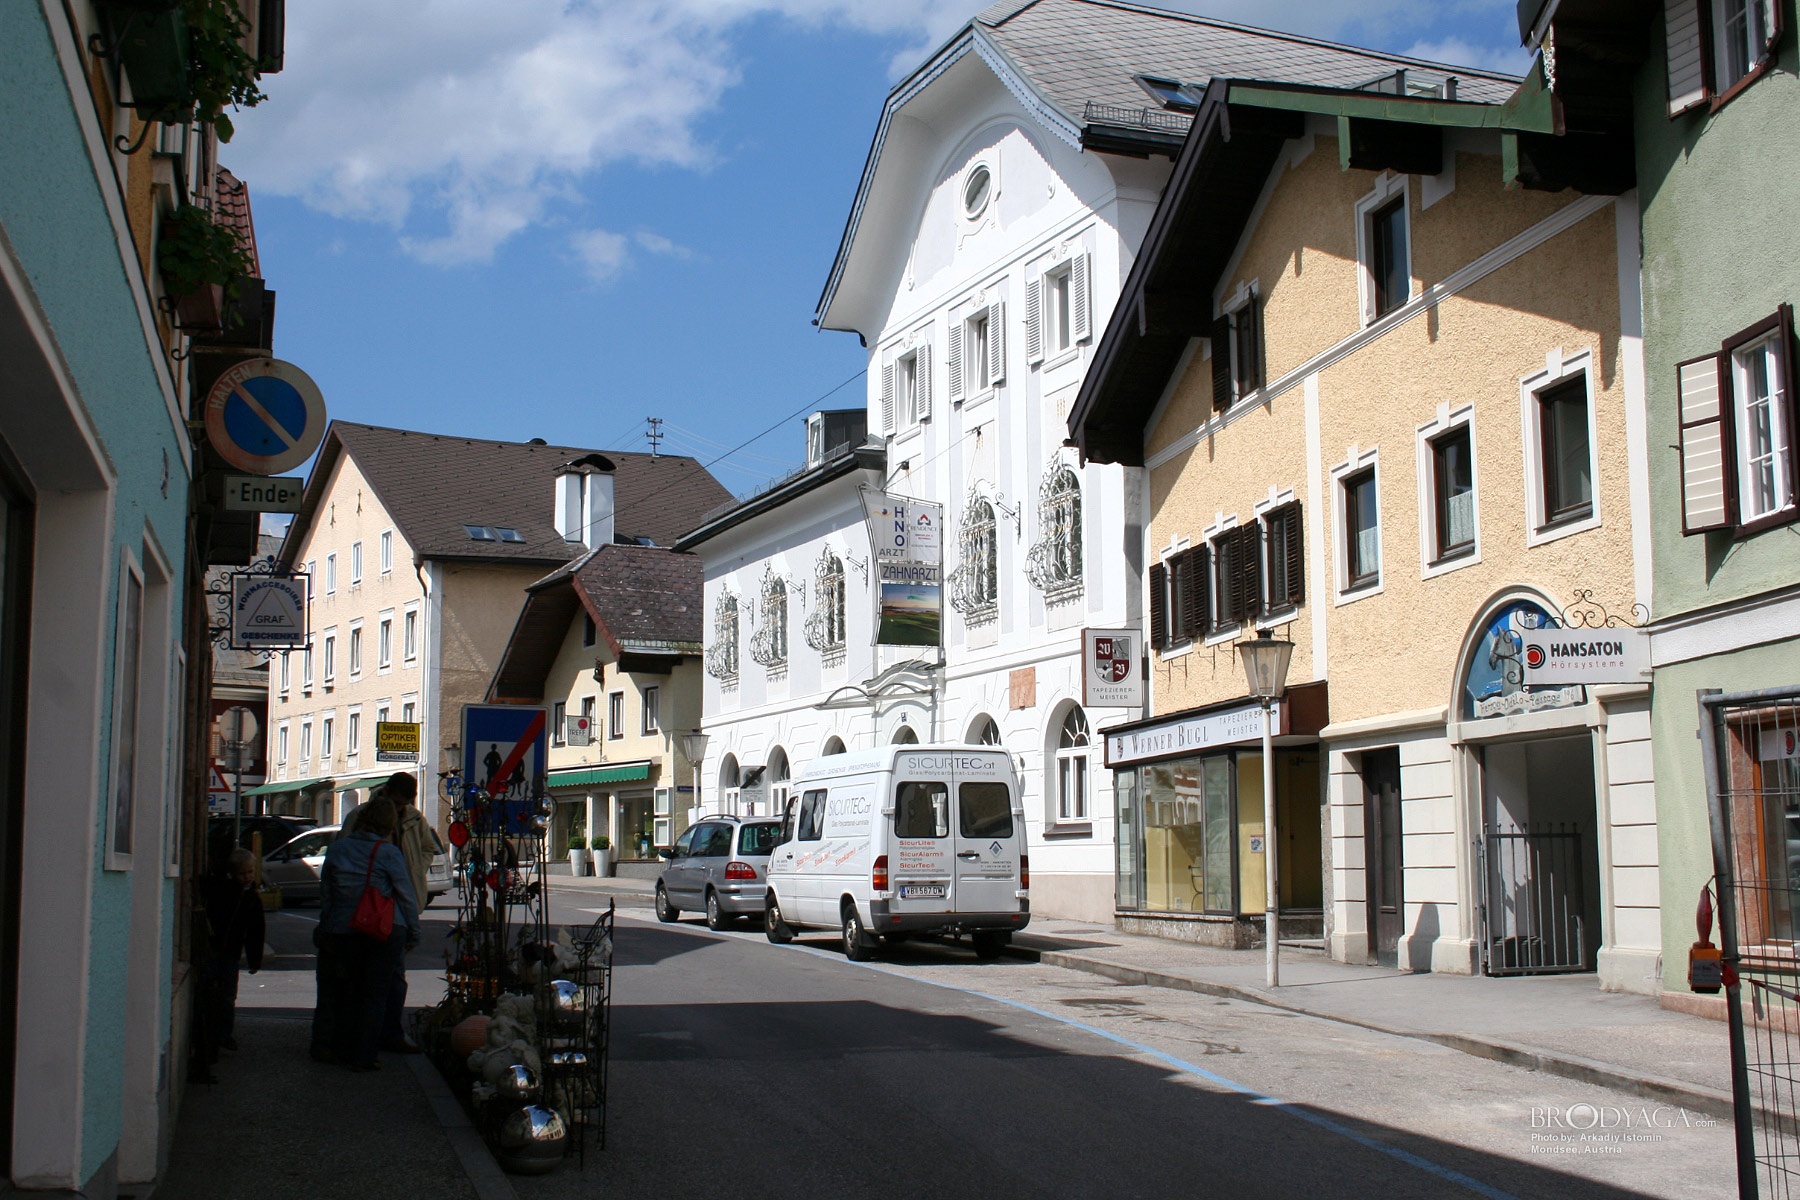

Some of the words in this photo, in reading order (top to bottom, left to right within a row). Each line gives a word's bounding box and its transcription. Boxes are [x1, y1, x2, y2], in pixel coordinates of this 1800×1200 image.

[209, 364, 251, 410] HALTEN
[241, 483, 288, 502] Ende
[894, 506, 905, 547] HNO
[879, 548, 905, 557] ARZT
[882, 565, 938, 581] ZAHNARZT
[255, 615, 285, 624] GRAF
[241, 632, 300, 640] GESCHENKE
[1551, 641, 1623, 657] HANSATON
[1551, 660, 1624, 670] Hörsysteme
[1227, 723, 1258, 737] MEISTER
[381, 733, 416, 742] OPTIKER
[1131, 733, 1173, 755] WERNER
[1178, 725, 1209, 747] BUGL
[380, 742, 417, 750] WIMMER
[908, 757, 995, 769] SICURTEC.at
[906, 887, 915, 895] VB
[919, 887, 931, 895] 567
